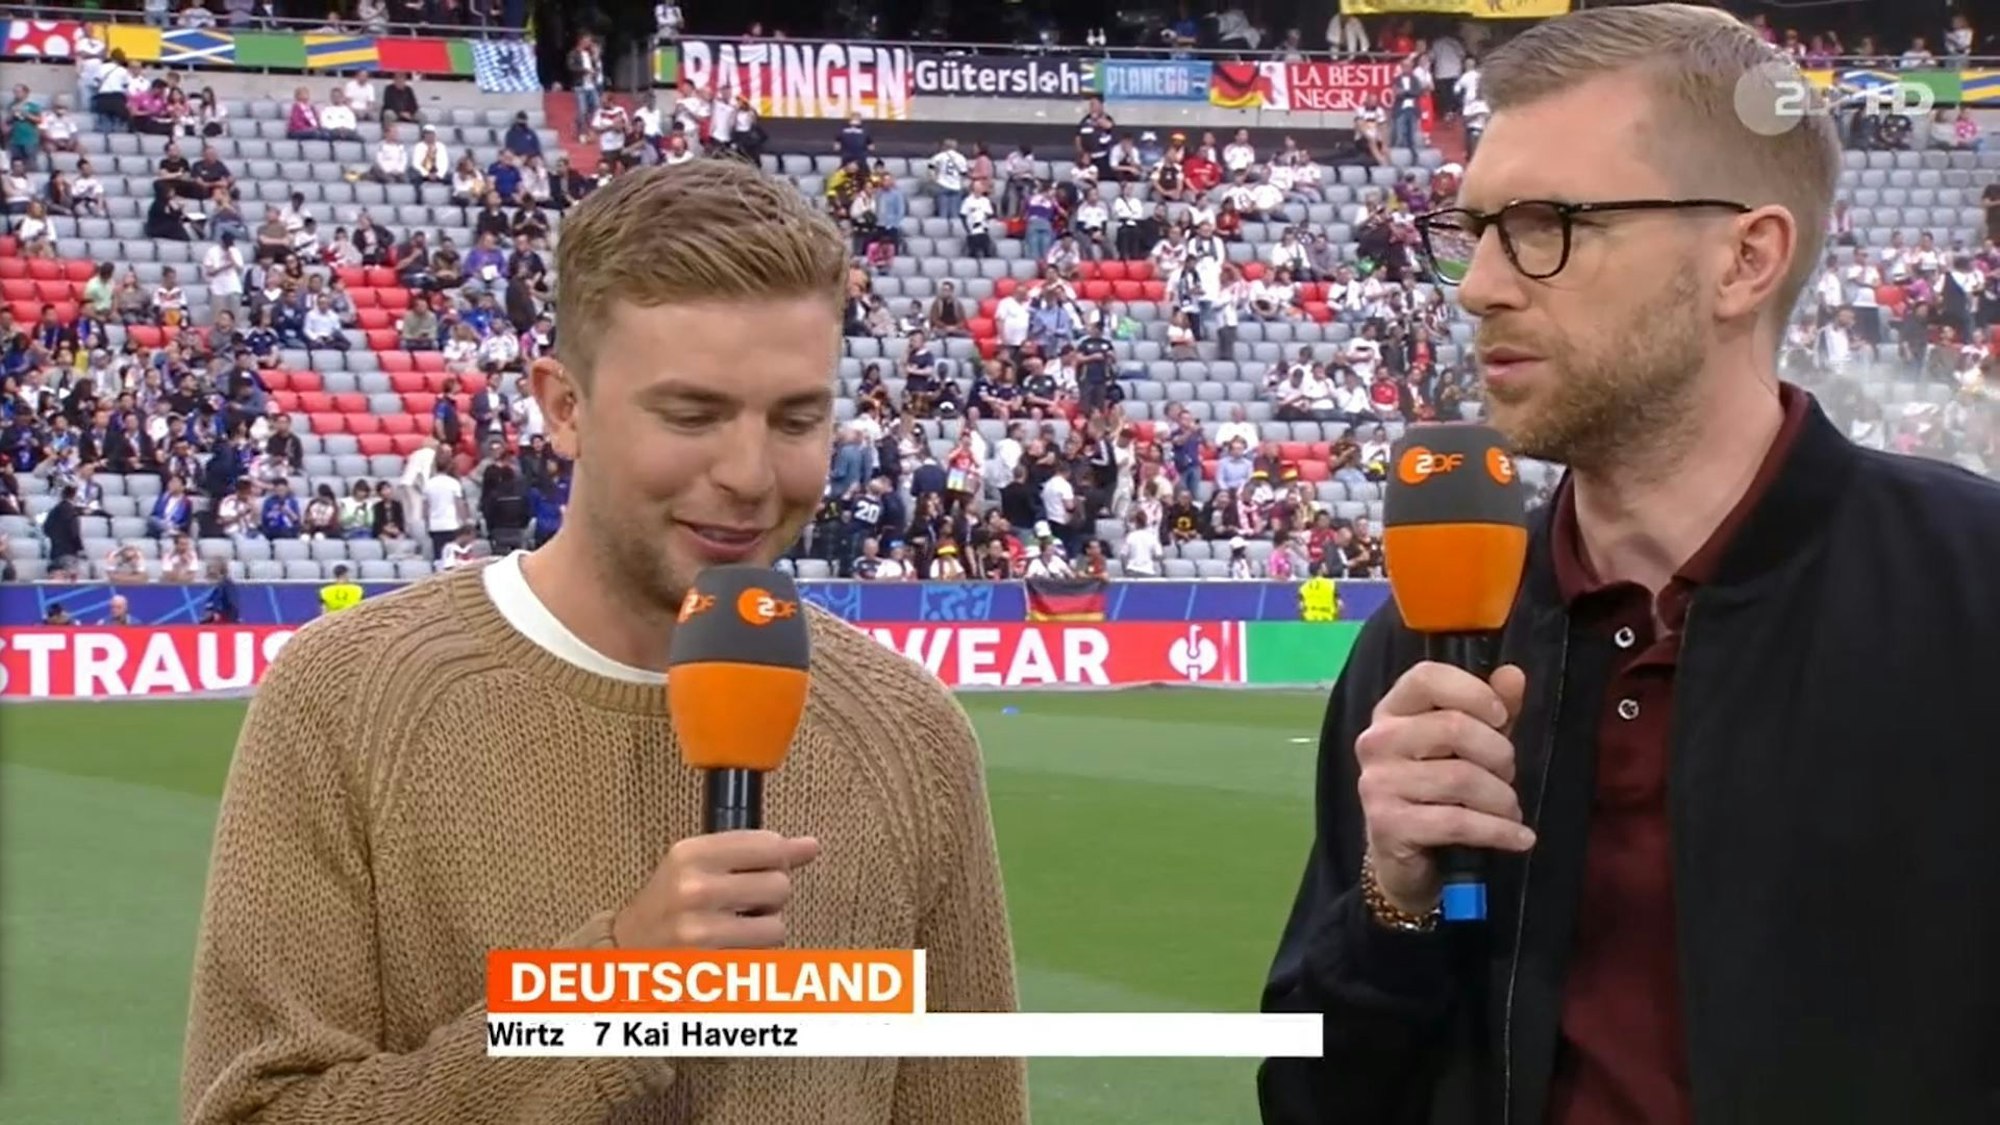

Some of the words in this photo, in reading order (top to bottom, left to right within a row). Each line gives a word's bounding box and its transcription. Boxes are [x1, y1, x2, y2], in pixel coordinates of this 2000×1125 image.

[916, 60, 1079, 94] Gütersloh
[1106, 67, 1188, 95] PLANEGG
[1292, 65, 1322, 86] LA
[1415, 453, 1464, 474] ZDF
[854, 500, 880, 523] 20
[0, 632, 294, 695] TRAU
[863, 628, 1110, 684] WEAR
